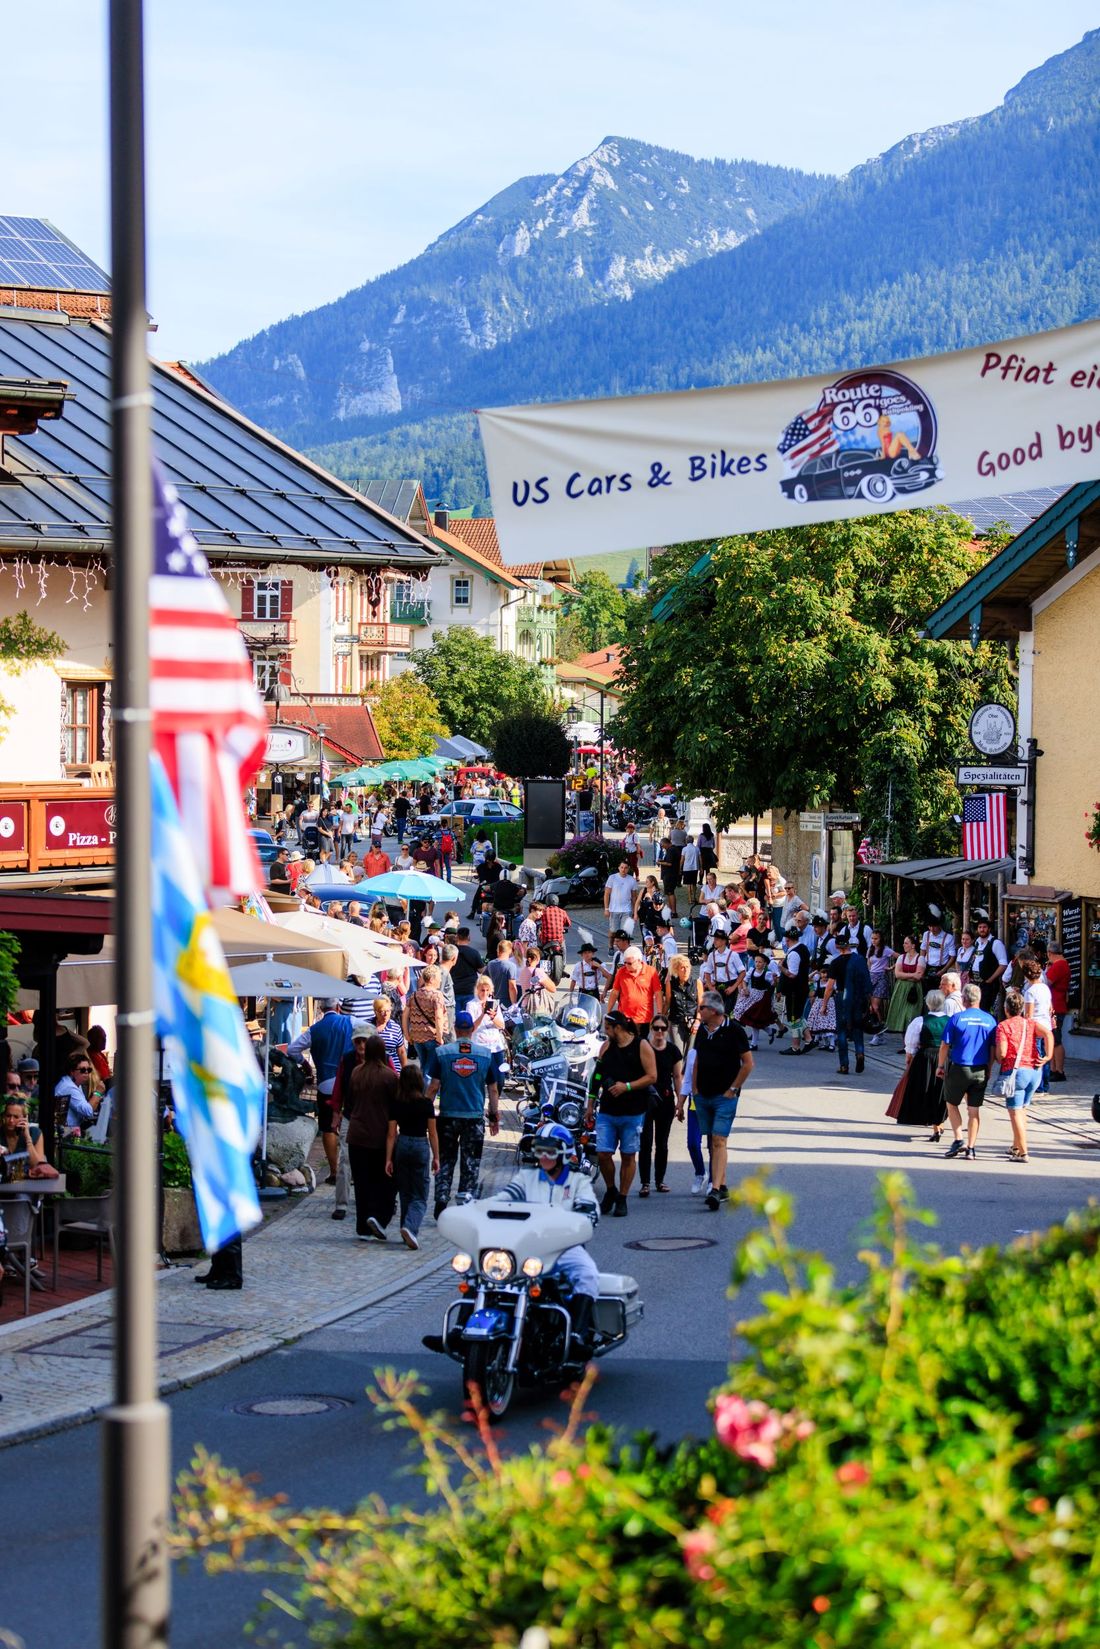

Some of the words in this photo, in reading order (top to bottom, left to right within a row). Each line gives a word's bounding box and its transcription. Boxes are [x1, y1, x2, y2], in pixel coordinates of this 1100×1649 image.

[980, 352, 1058, 385] Pfiat
[823, 383, 882, 404] Route
[880, 395, 907, 408] goes
[832, 399, 880, 431] 66
[977, 431, 1043, 477] Good
[512, 477, 550, 507] US
[565, 472, 632, 499] Cars
[647, 462, 672, 488] &
[688, 450, 768, 482] Bikes
[571, 779, 583, 790] 12
[68, 832, 98, 846] Pizza
